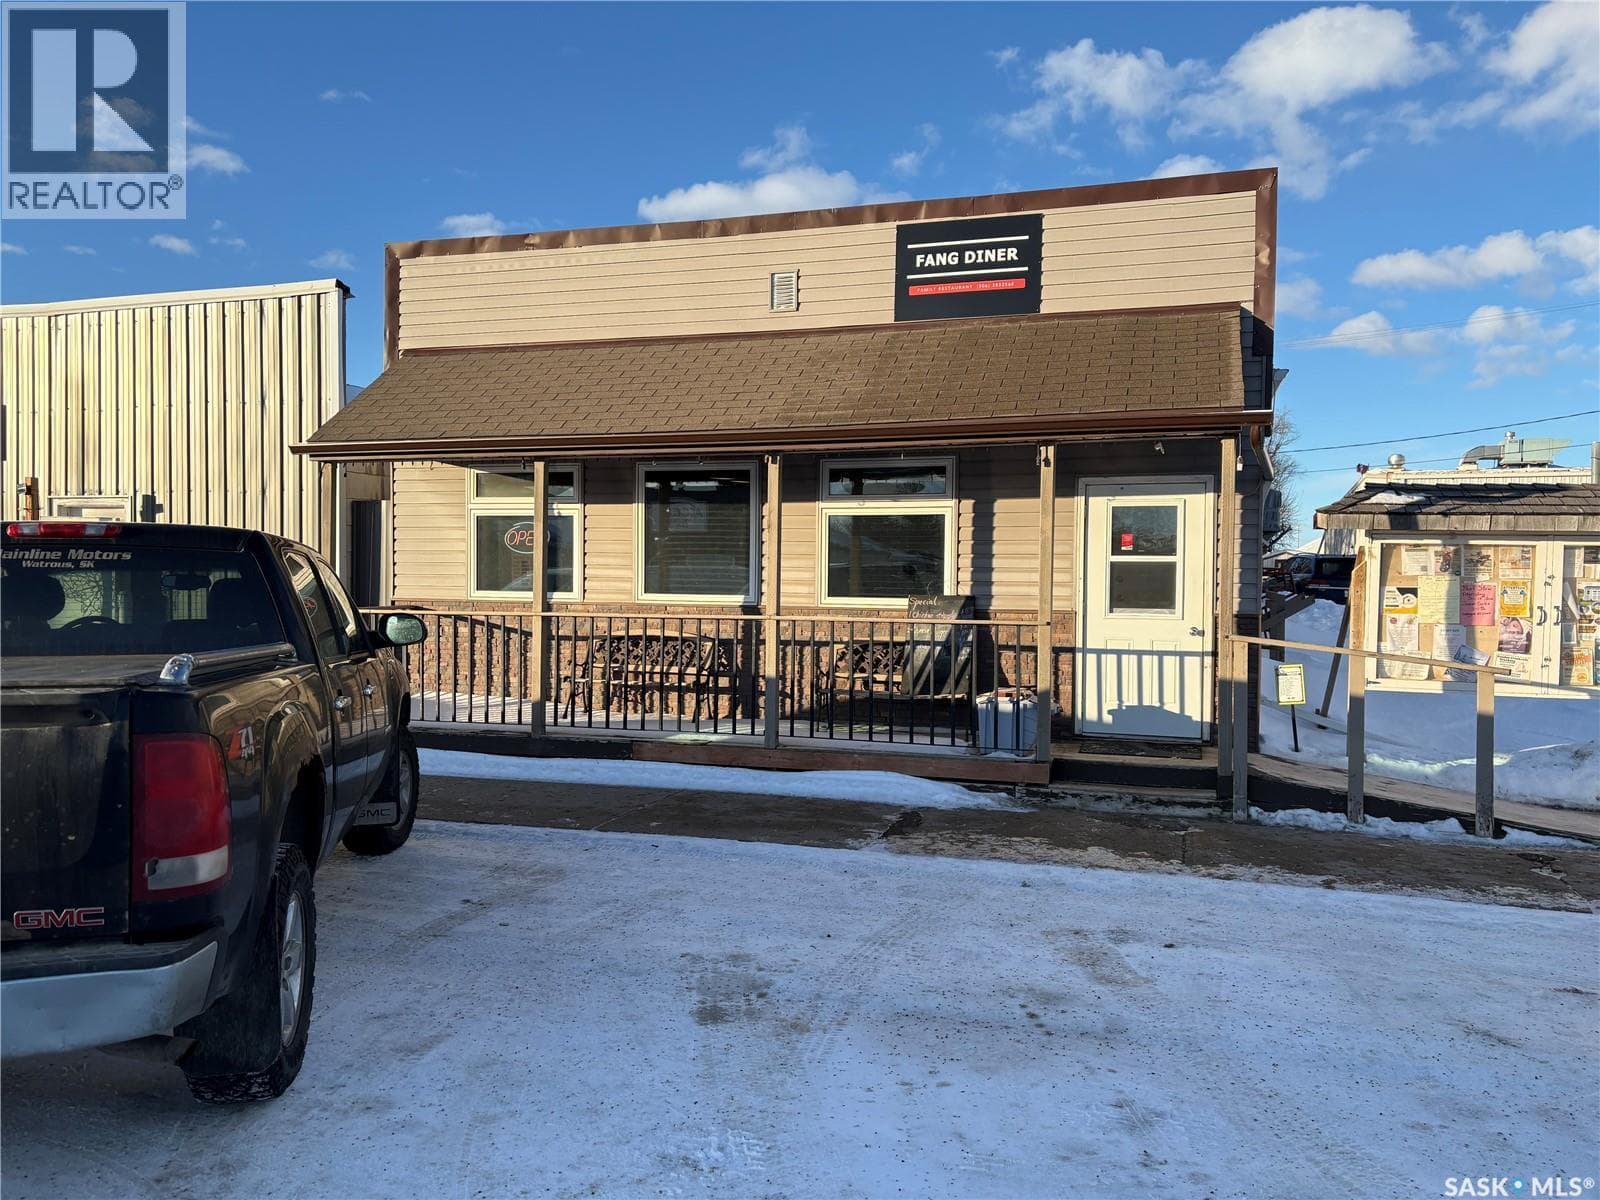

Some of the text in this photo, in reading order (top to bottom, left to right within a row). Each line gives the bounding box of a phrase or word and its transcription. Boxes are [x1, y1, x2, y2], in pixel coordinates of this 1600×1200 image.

[915, 247, 1019, 268] FANG DINER
[938, 284, 973, 292] RESTAURANT
[507, 530, 535, 546] OPE
[0, 548, 132, 560] ainline Motors
[22, 560, 95, 569] Watrous, SK
[908, 595, 938, 610] Special
[13, 906, 105, 930] GMC
